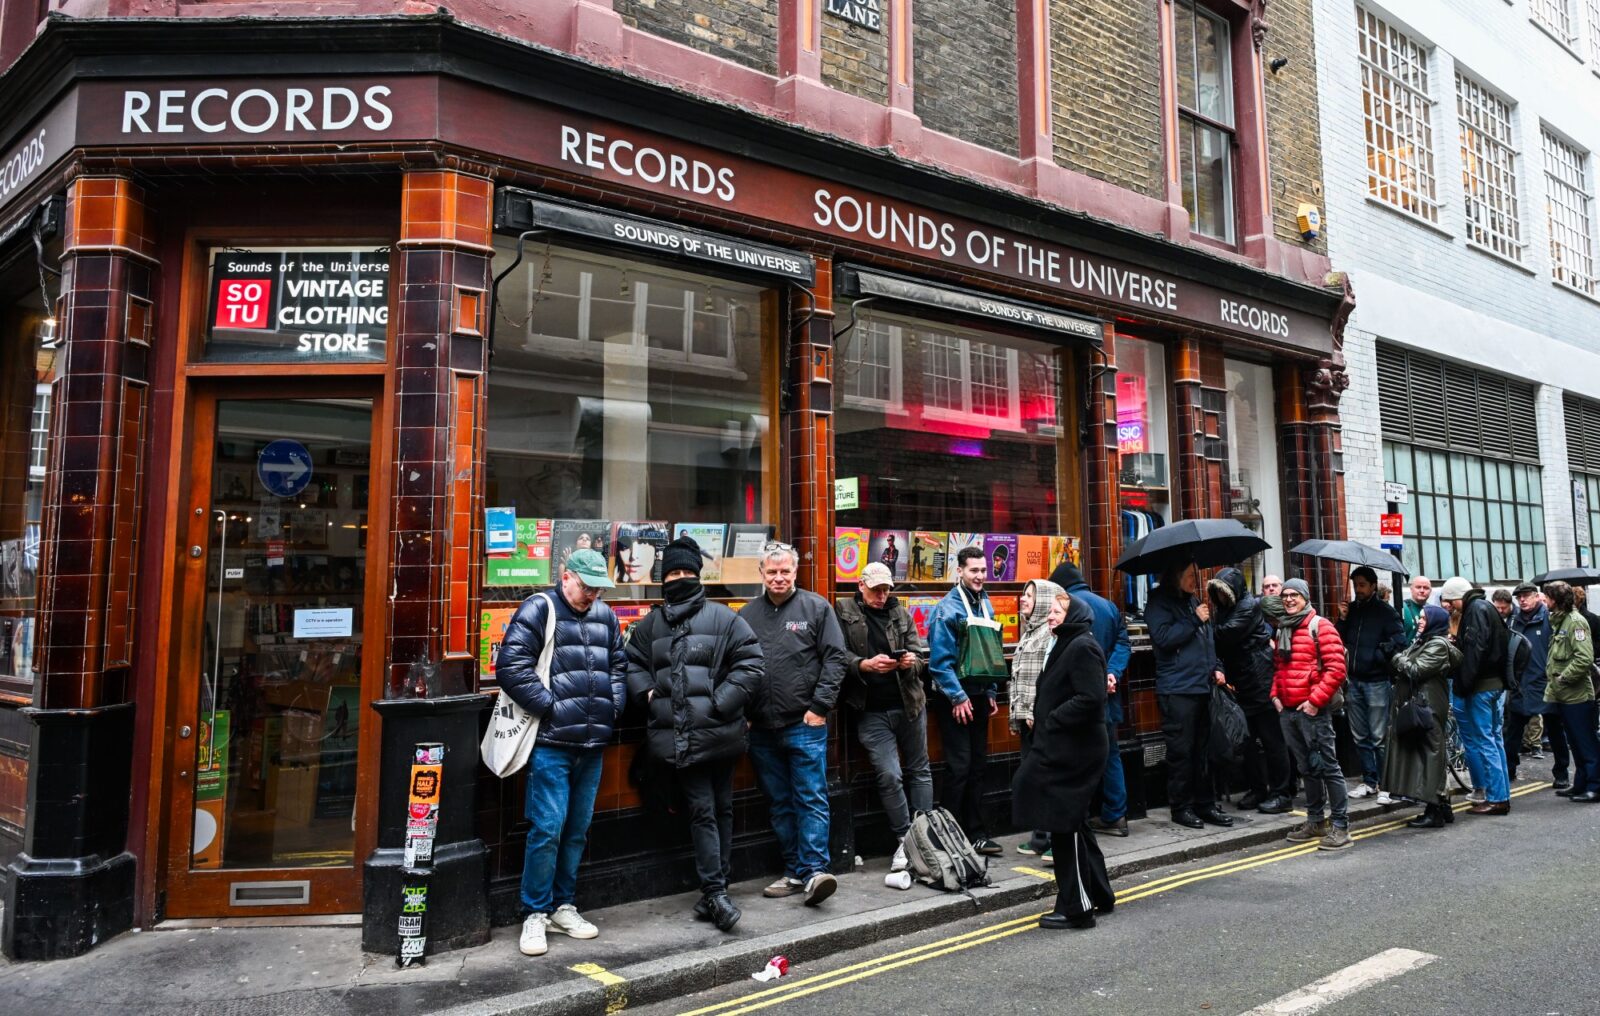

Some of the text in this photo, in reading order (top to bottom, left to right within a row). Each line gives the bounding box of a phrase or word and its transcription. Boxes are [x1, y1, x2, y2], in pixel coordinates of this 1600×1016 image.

[828, 0, 880, 29] LANE
[121, 85, 393, 134] RECORDS
[561, 125, 736, 202] RECORDS
[614, 223, 801, 274] SOUNDS OF THE UNIVERSE
[813, 188, 1178, 311] SOUNDS OF THE UNIVERSE
[227, 261, 390, 273] Sounds of the Universe
[226, 283, 263, 302] SO
[286, 279, 384, 298] VINTAGE
[226, 304, 259, 323] TU
[278, 306, 388, 325] CLOTHING
[979, 302, 1097, 335] SOUNDS OF THE UNIVERSE
[1220, 298, 1289, 338] RECORDS
[296, 333, 370, 352] STORE
[1026, 551, 1042, 559] COLD
[496, 568, 510, 577] THE
